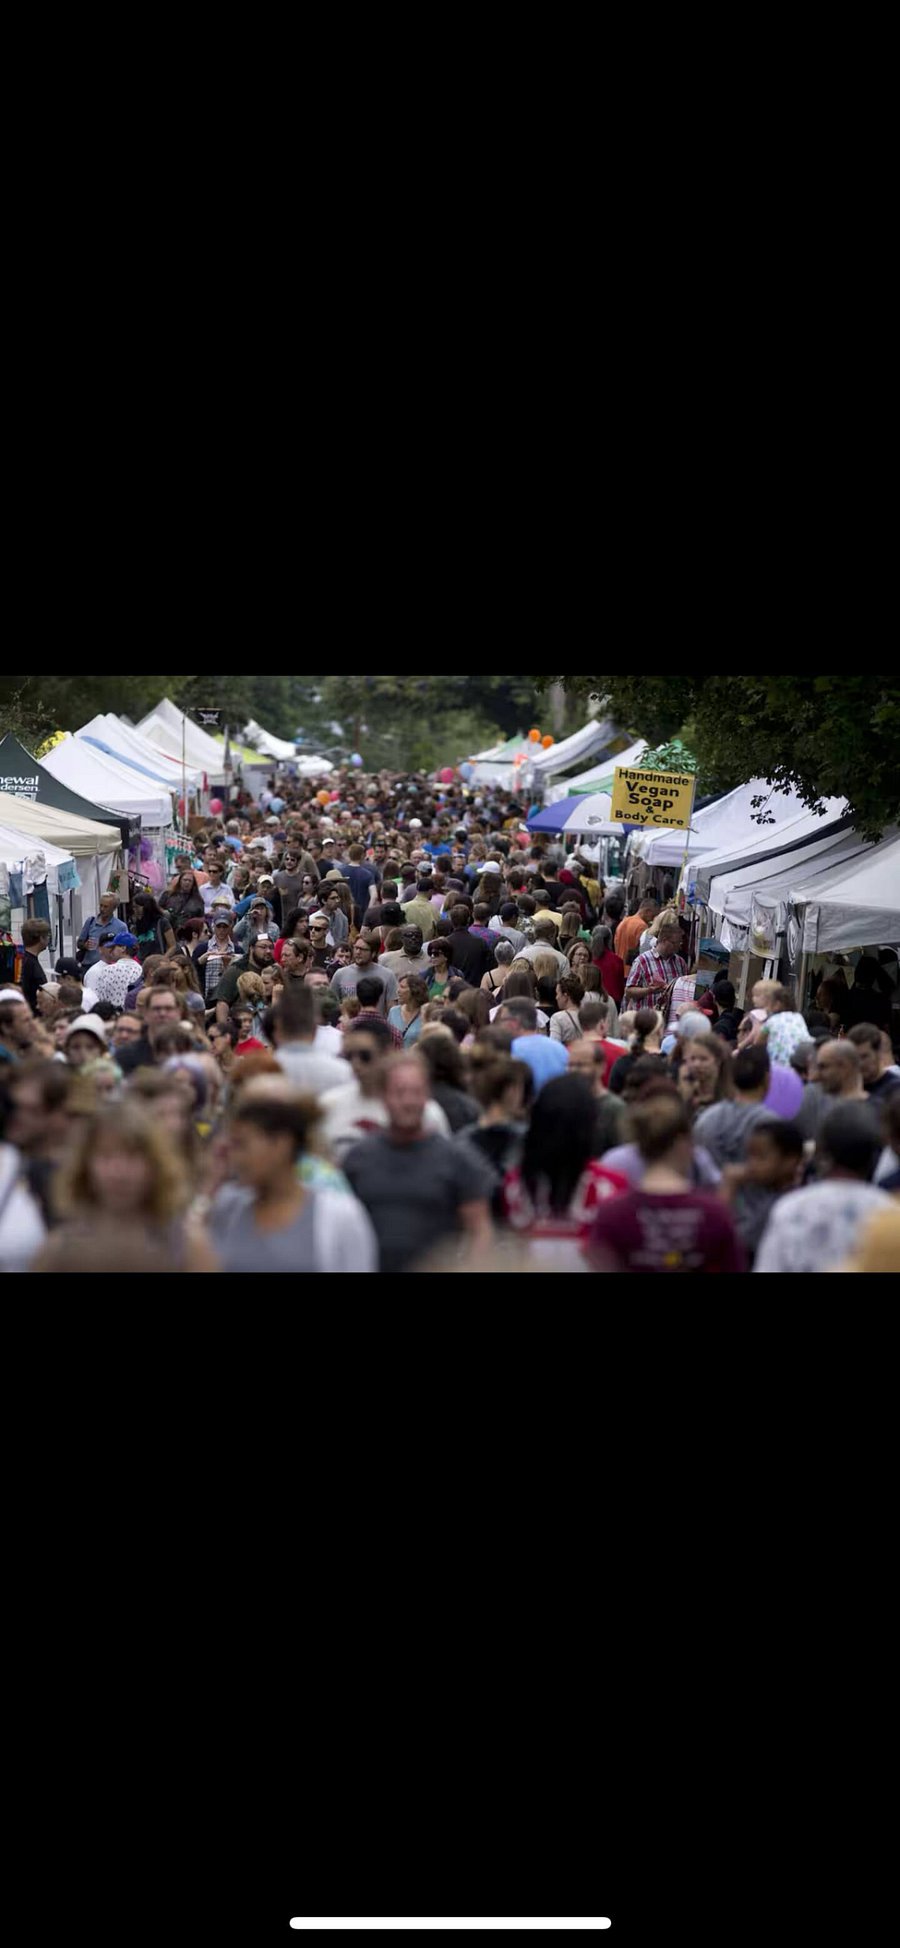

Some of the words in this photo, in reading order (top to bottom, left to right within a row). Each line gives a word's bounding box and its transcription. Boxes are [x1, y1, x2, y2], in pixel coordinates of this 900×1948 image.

[619, 769, 689, 786] Handmade
[626, 781, 680, 798] Vegan
[629, 793, 674, 812] Soap
[645, 806, 654, 814] &
[615, 810, 648, 823] Body
[653, 815, 684, 826] Care
